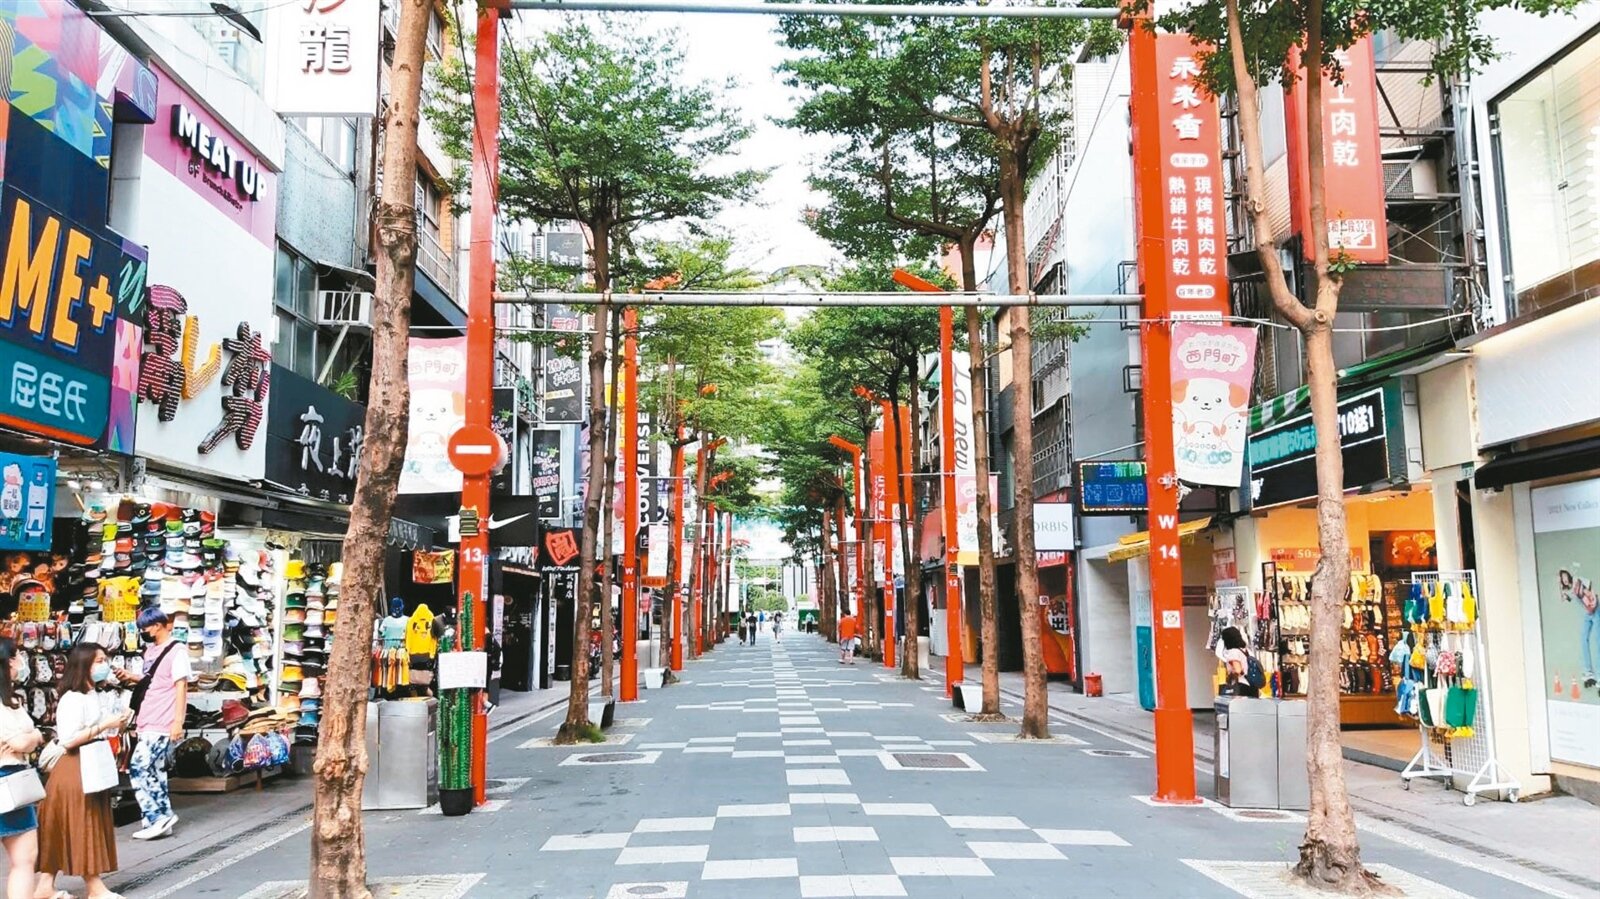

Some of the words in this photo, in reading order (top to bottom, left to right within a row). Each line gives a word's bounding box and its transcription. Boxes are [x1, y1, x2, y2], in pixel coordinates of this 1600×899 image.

[171, 104, 238, 179] MEAT
[236, 161, 268, 201] UP
[1186, 349, 1240, 366] 西門町
[10, 361, 88, 423] 屈臣氏
[955, 420, 969, 471] new
[637, 412, 651, 527] CONVERSE
[1158, 515, 1175, 529] W
[463, 548, 481, 562] 13
[1160, 545, 1178, 559] 14
